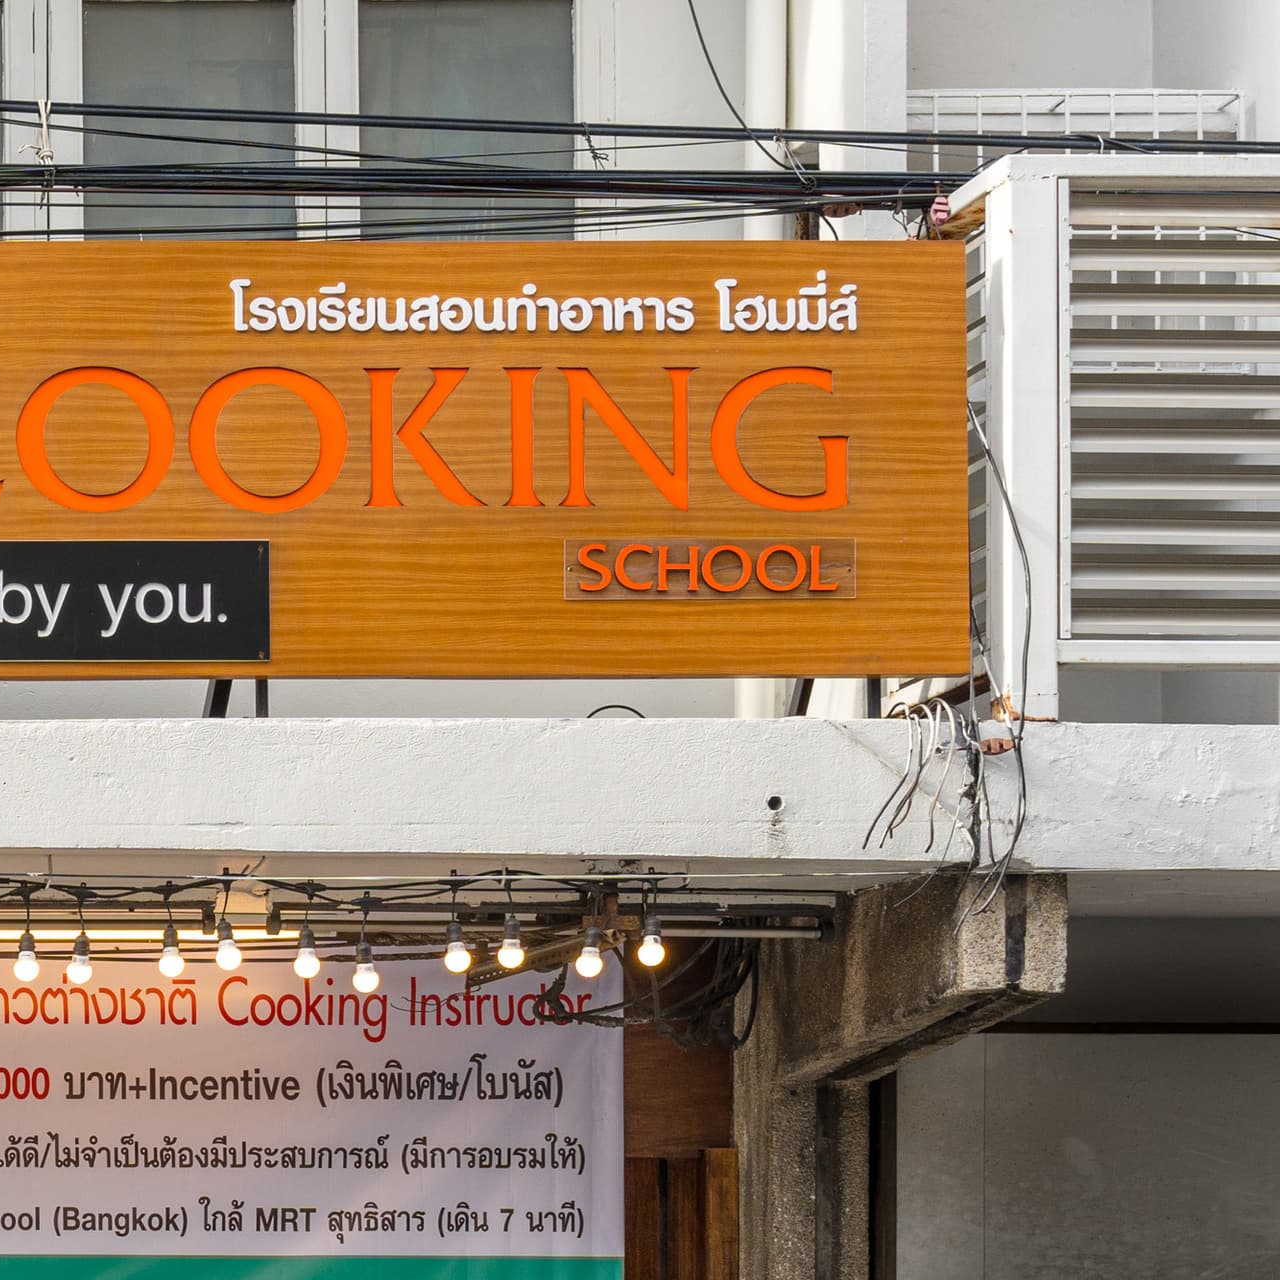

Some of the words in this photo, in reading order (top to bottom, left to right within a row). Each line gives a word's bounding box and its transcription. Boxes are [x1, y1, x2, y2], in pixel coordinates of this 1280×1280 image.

[229, 278, 696, 333] โรงเรียนสอนทำอาหาร
[714, 269, 858, 333] โฮมมี่ส์
[576, 543, 839, 593] SCHOOL
[97, 583, 228, 639] you.
[216, 975, 388, 1043] Cooking
[63, 1067, 301, 1101] บาท+Incentive
[316, 1052, 564, 1108] (เงินพิเศษ/โบนัส)
[401, 1132, 587, 1176] (มีการอบรมให้)
[53, 1206, 188, 1238] (Bangkok)
[197, 1196, 245, 1232] ใกล้
[255, 1207, 317, 1233] MRT
[327, 1201, 426, 1245] สุทธิสาร
[437, 1201, 490, 1238] (เดิน
[499, 1208, 516, 1233] 7
[525, 1200, 585, 1239] นาที)
